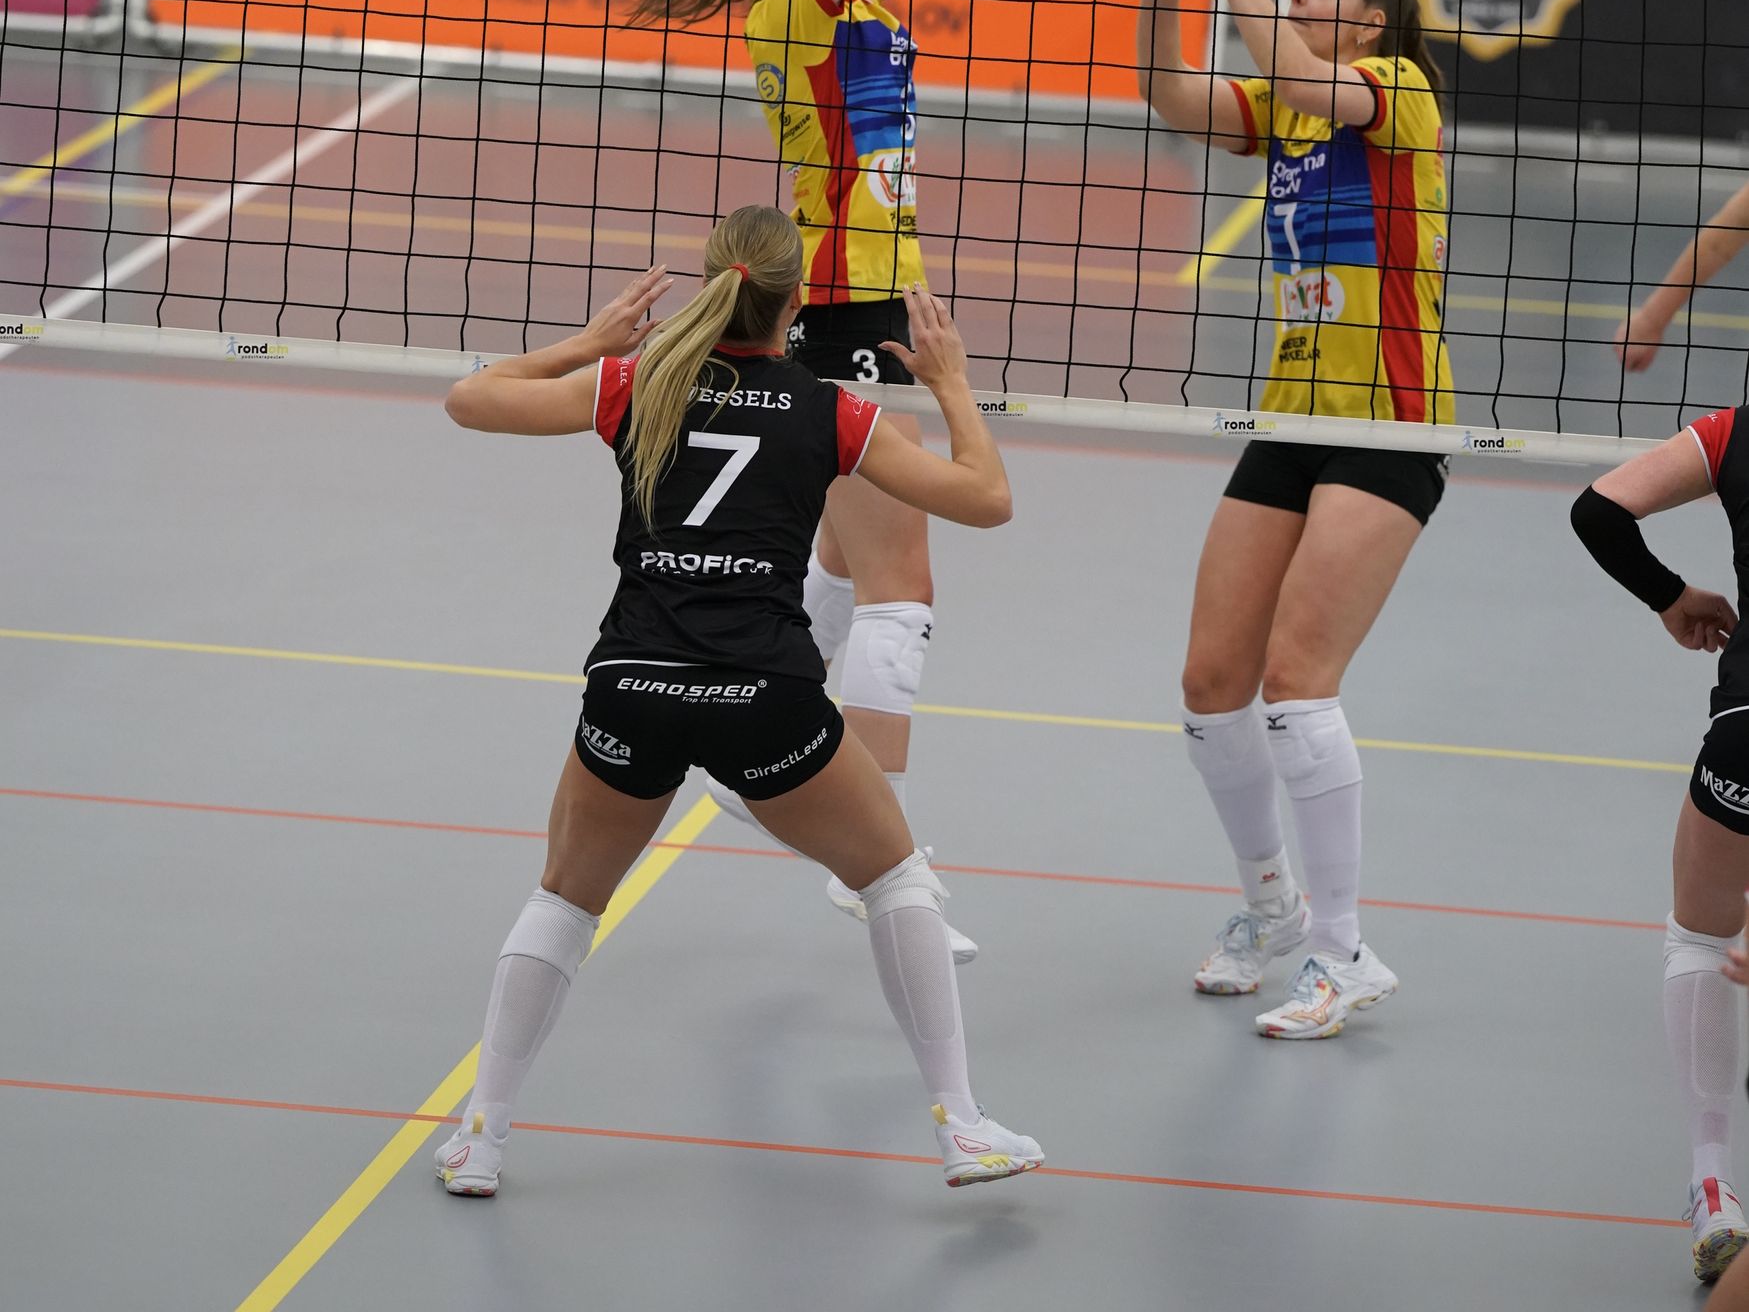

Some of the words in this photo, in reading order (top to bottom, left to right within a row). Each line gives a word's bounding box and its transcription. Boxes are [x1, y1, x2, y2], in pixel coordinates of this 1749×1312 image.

[1274, 202, 1302, 275] 7
[0, 323, 44, 335] ondom
[238, 343, 288, 355] rondom
[852, 349, 880, 383] 3
[977, 401, 1028, 413] rondom
[1224, 419, 1275, 431] rondom
[1474, 437, 1525, 448] rondom
[682, 431, 761, 527] 7
[582, 716, 631, 758] aZZa
[744, 727, 828, 780] DirectLease
